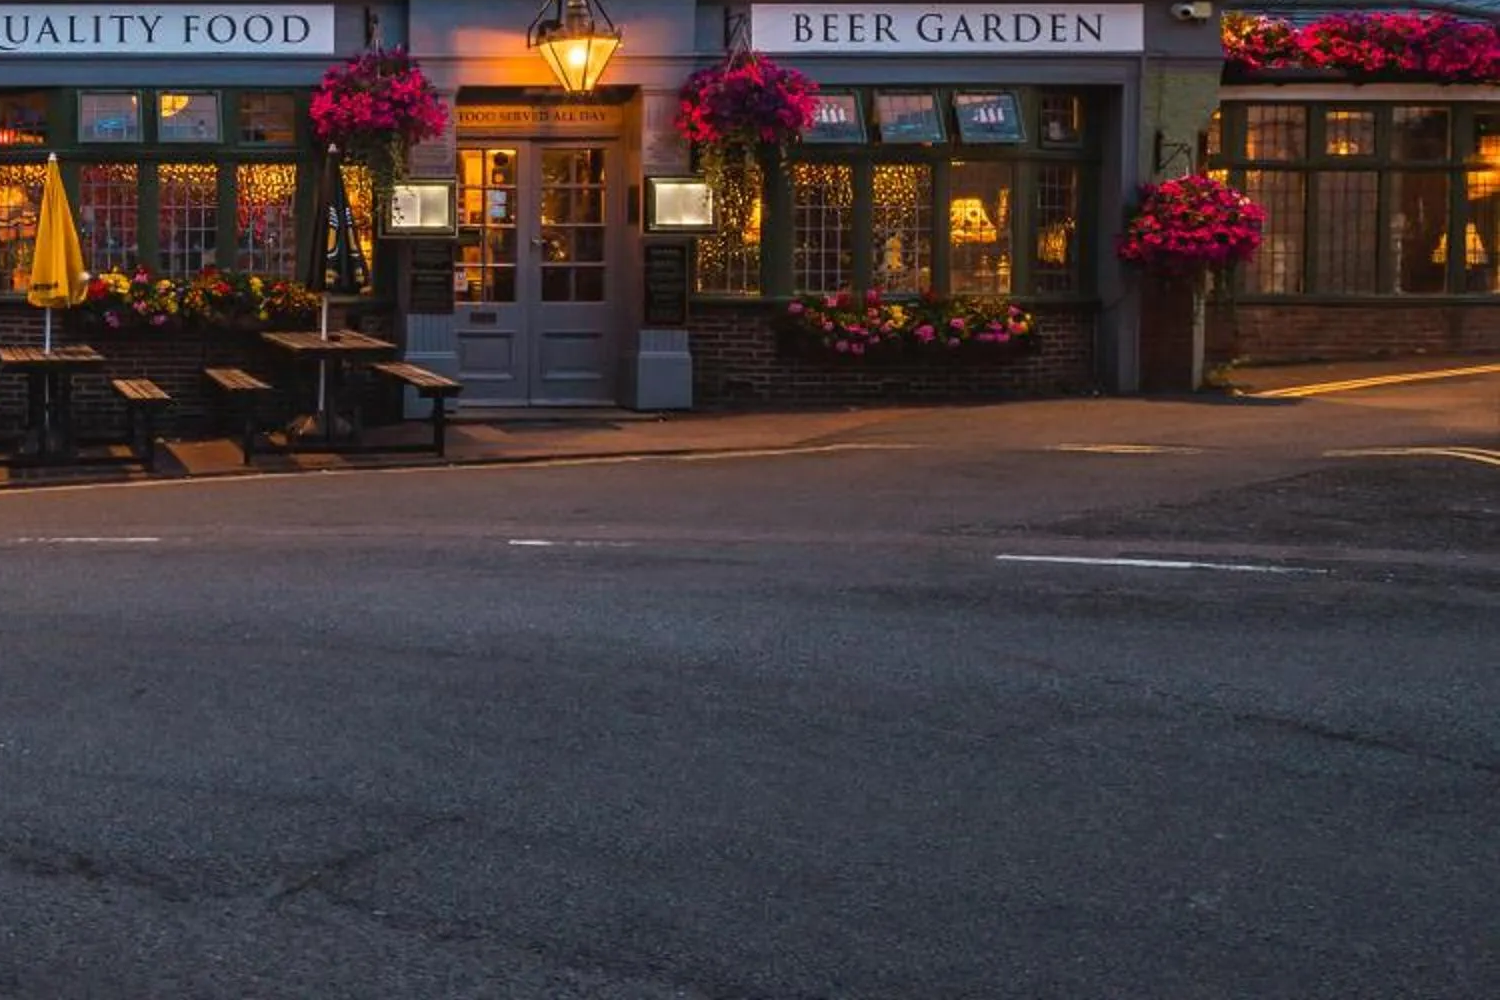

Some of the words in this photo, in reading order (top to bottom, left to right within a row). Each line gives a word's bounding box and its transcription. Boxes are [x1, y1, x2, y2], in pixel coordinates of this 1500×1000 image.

[184, 14, 311, 44] FOOD
[792, 13, 900, 43] BEER
[915, 13, 1104, 44] GARDEN
